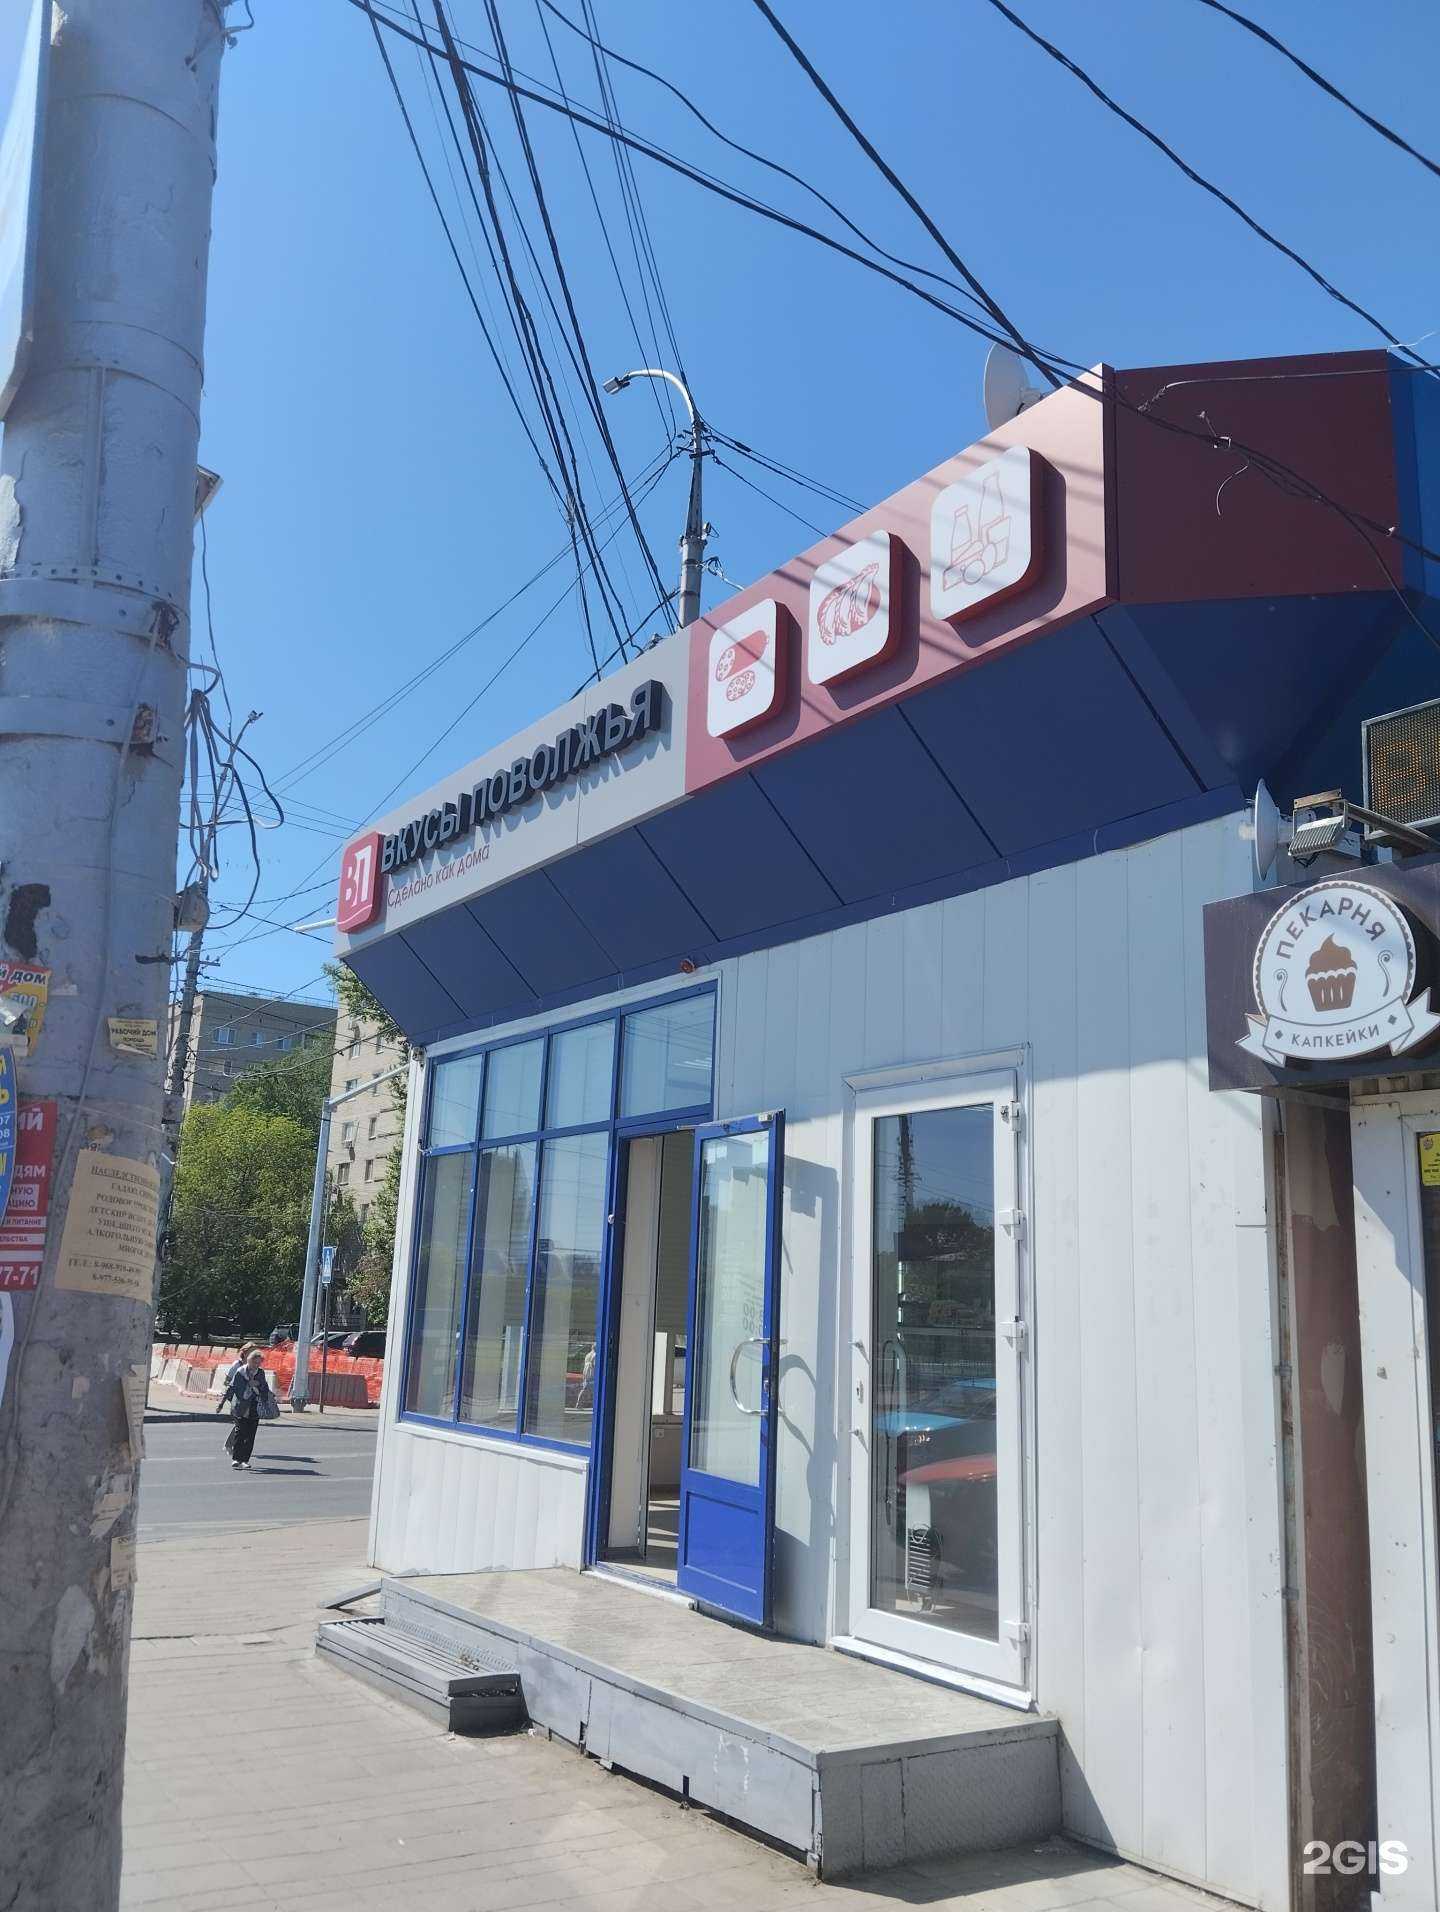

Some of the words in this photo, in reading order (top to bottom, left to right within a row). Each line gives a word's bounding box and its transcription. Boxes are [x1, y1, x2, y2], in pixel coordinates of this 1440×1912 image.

[381, 794, 469, 873] ВКУСЫ
[469, 679, 658, 826] ПОВОЛЖЬЯ
[436, 864, 455, 884] как
[457, 845, 490, 878] дома
[1276, 896, 1386, 960] ПЕКАРНЯ
[10, 969, 46, 985] ДОМ
[1291, 1023, 1381, 1048] КАПКЕЙКИ
